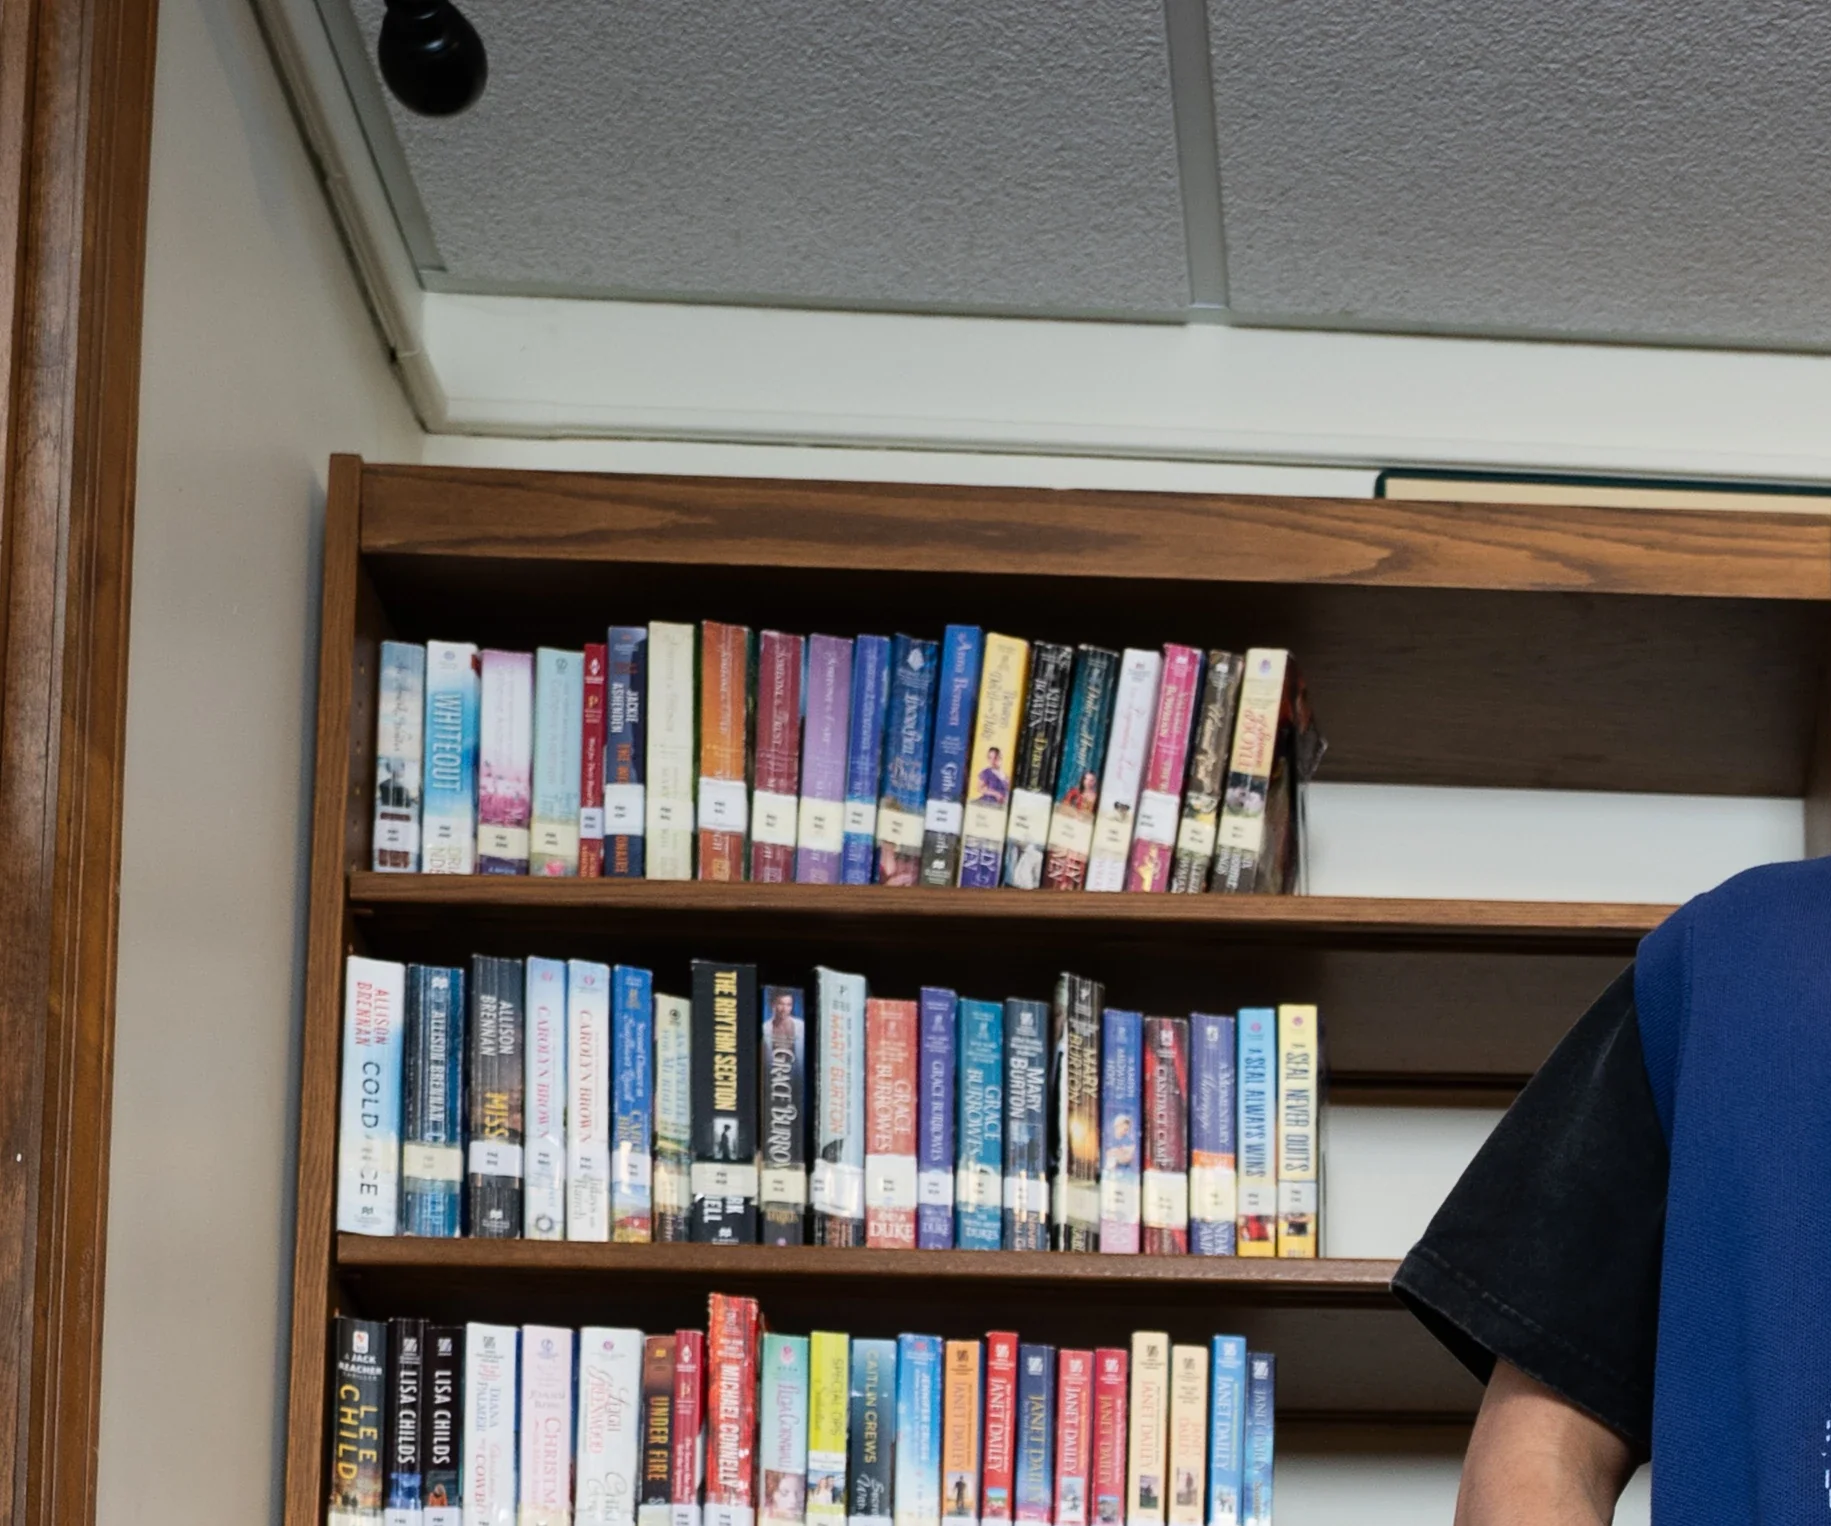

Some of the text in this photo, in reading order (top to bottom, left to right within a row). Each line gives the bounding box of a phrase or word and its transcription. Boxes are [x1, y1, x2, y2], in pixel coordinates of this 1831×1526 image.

[610, 682, 624, 733] ASHENDEN
[625, 690, 639, 724] JACKIE
[432, 694, 461, 792] WHITEOUT
[479, 996, 497, 1056] BRENNAN
[498, 1002, 514, 1055] ALLISON
[713, 971, 737, 1112] THE RHYTHM SECTION
[361, 1061, 380, 1129] COLD
[770, 1048, 795, 1101] GRACE
[1009, 1057, 1029, 1119] BURTON
[1027, 1068, 1045, 1113] MARY
[1245, 1058, 1264, 1177] SEAL ALWAYS WINS
[337, 1384, 361, 1480] CHILD
[357, 1404, 378, 1464] LEE
[432, 1369, 452, 1464] LISA CHILDS
[649, 1396, 672, 1480] UNDER FIRE
[717, 1365, 741, 1490] MICHAEL CONNELLY
[863, 1350, 878, 1463] CAITLIN CREWS
